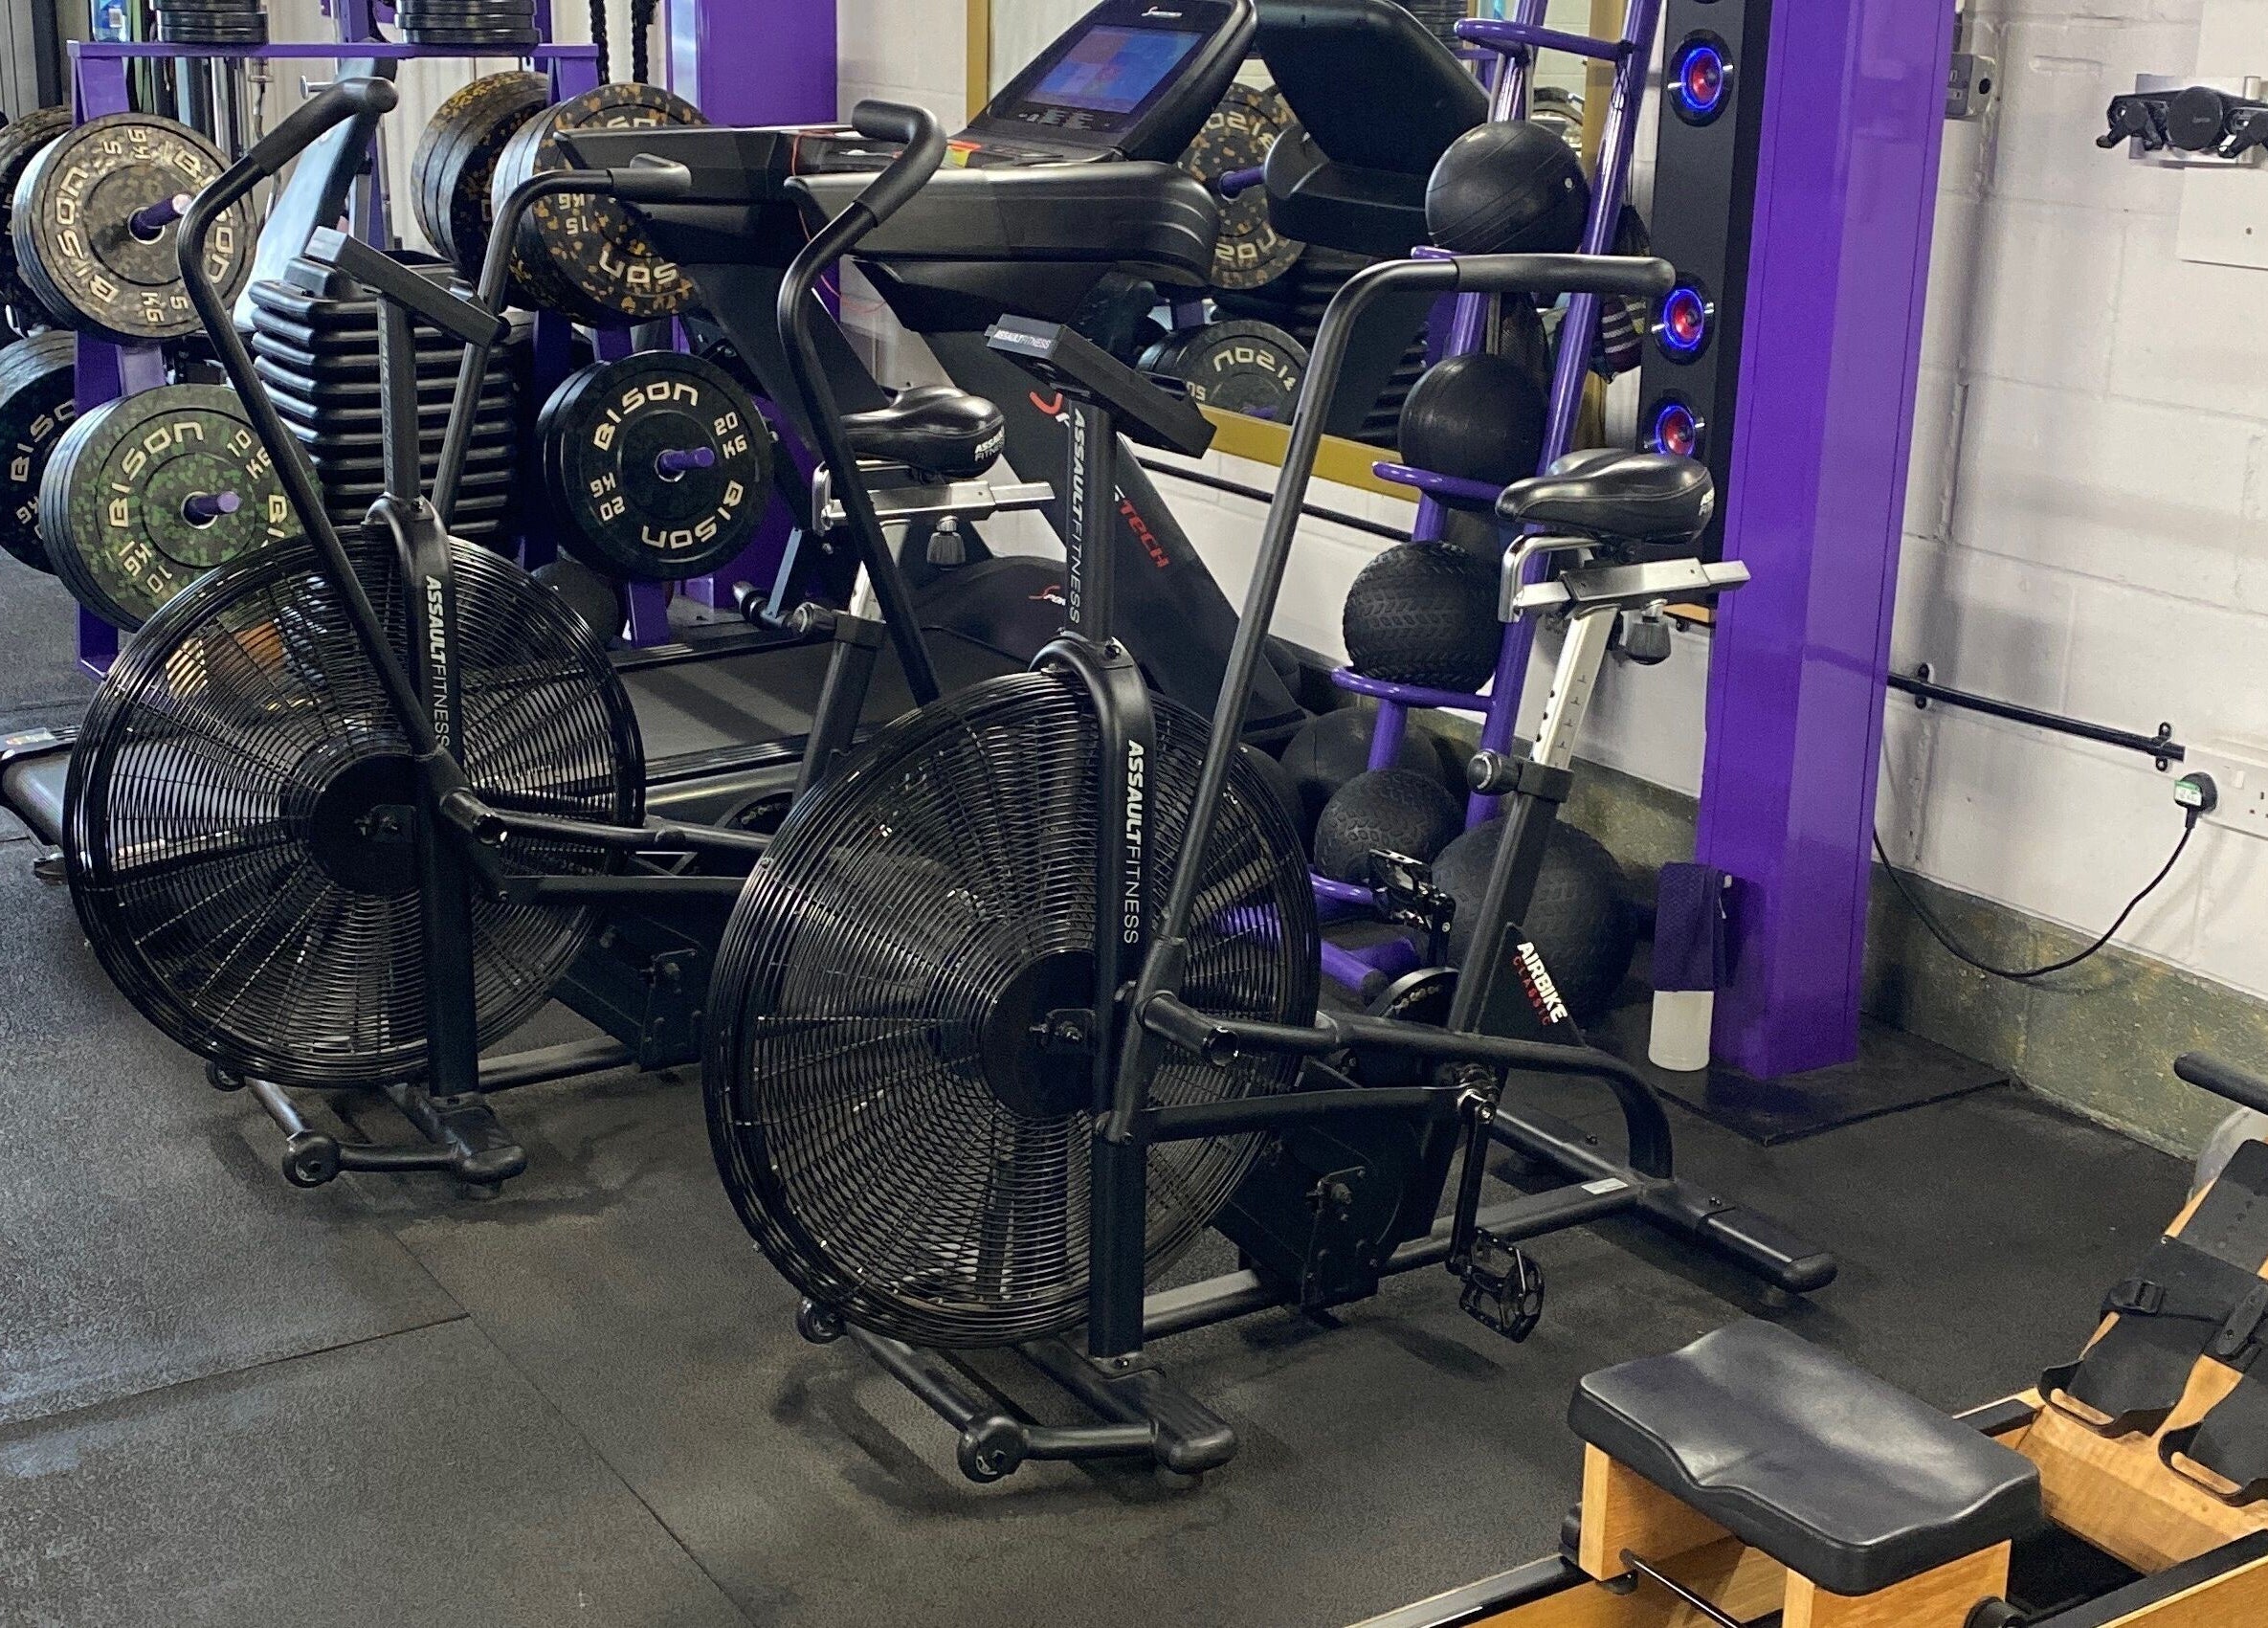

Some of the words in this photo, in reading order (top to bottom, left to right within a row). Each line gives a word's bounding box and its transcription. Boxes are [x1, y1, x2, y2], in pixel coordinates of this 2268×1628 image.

[126, 128, 151, 160] KG
[56, 166, 120, 303] BISON
[566, 215, 589, 235] 15
[599, 249, 679, 285] SON
[141, 291, 166, 323] KG
[593, 380, 699, 452] BISON
[713, 411, 739, 436] 20
[11, 398, 76, 482] BISO
[227, 428, 253, 457] 10
[723, 434, 748, 459] KG
[108, 420, 205, 529] BISON
[589, 472, 616, 499] KG
[599, 496, 626, 522] 20
[641, 479, 745, 549] BISON
[123, 543, 152, 577] KG
[146, 564, 173, 594] 10
[1517, 942, 1568, 1024] AIRBIKE
